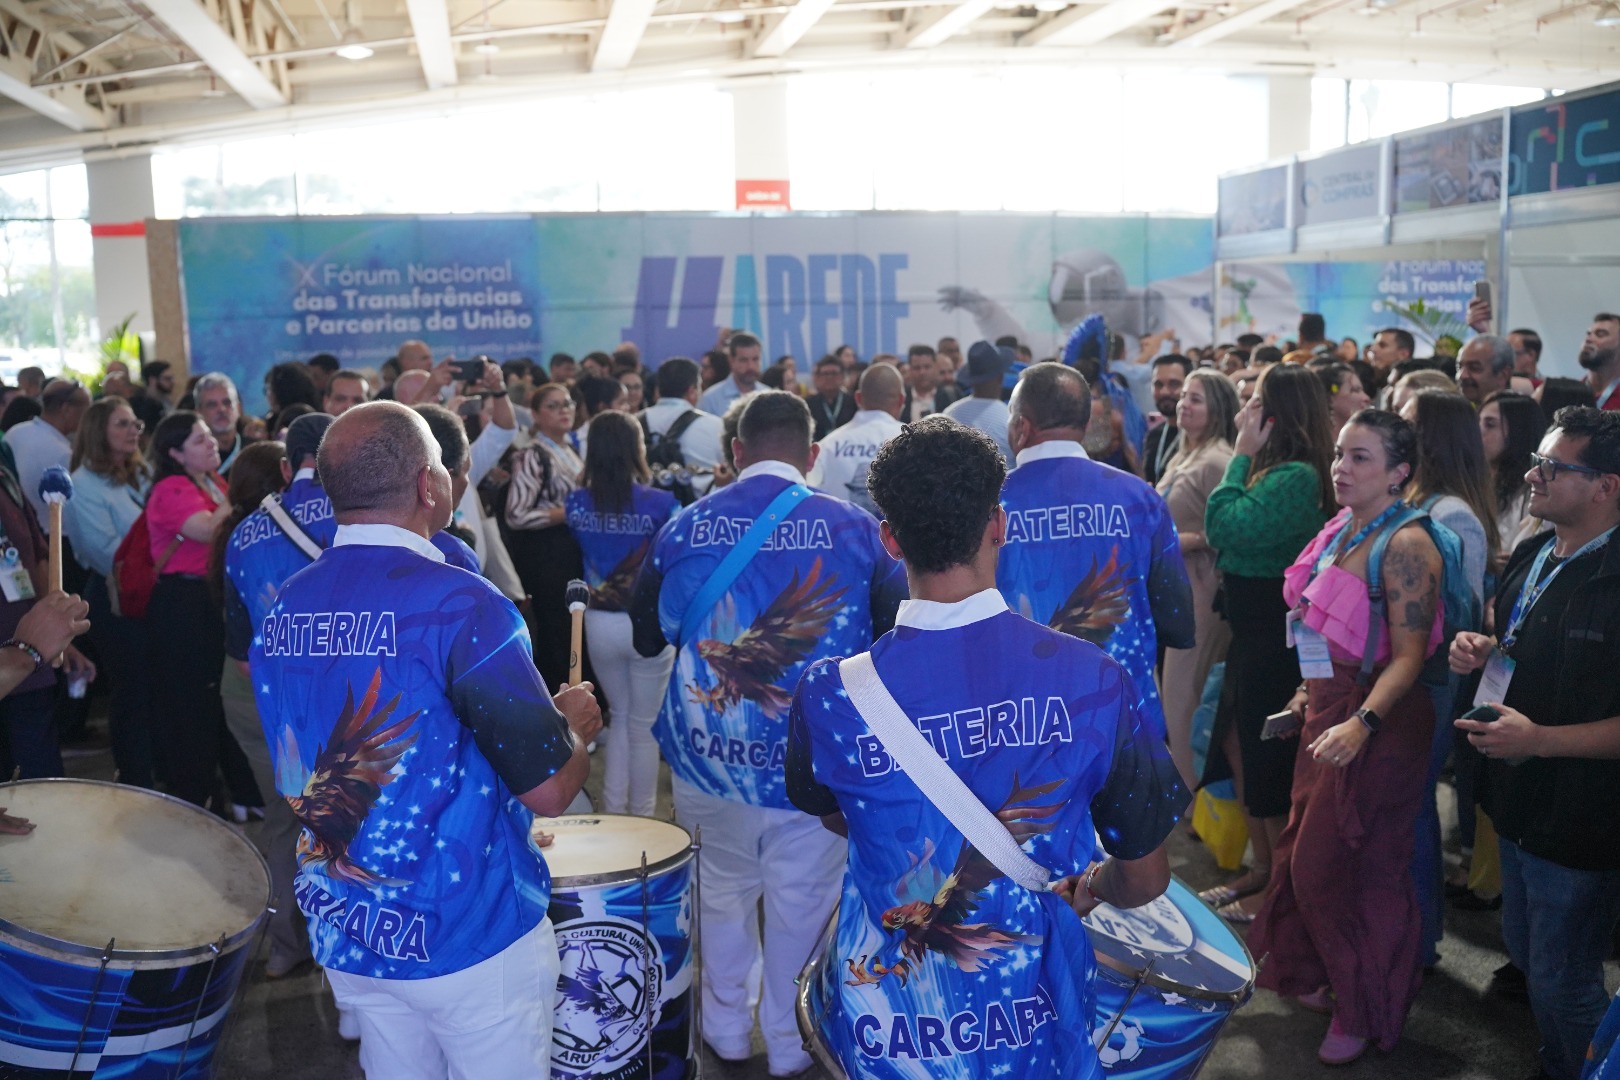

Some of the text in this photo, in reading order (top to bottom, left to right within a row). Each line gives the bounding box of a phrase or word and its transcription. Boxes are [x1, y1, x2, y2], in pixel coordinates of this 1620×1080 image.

[323, 262, 400, 287] Fórum
[408, 258, 513, 285] Nacional
[1378, 274, 1408, 293] das
[293, 285, 523, 311] das Transferências
[285, 307, 533, 336] e Parcerias da União
[1003, 503, 1131, 544] ATERIA
[262, 611, 397, 657] BATERIA
[690, 726, 787, 771] CARCA
[856, 697, 1073, 778] BTERIA
